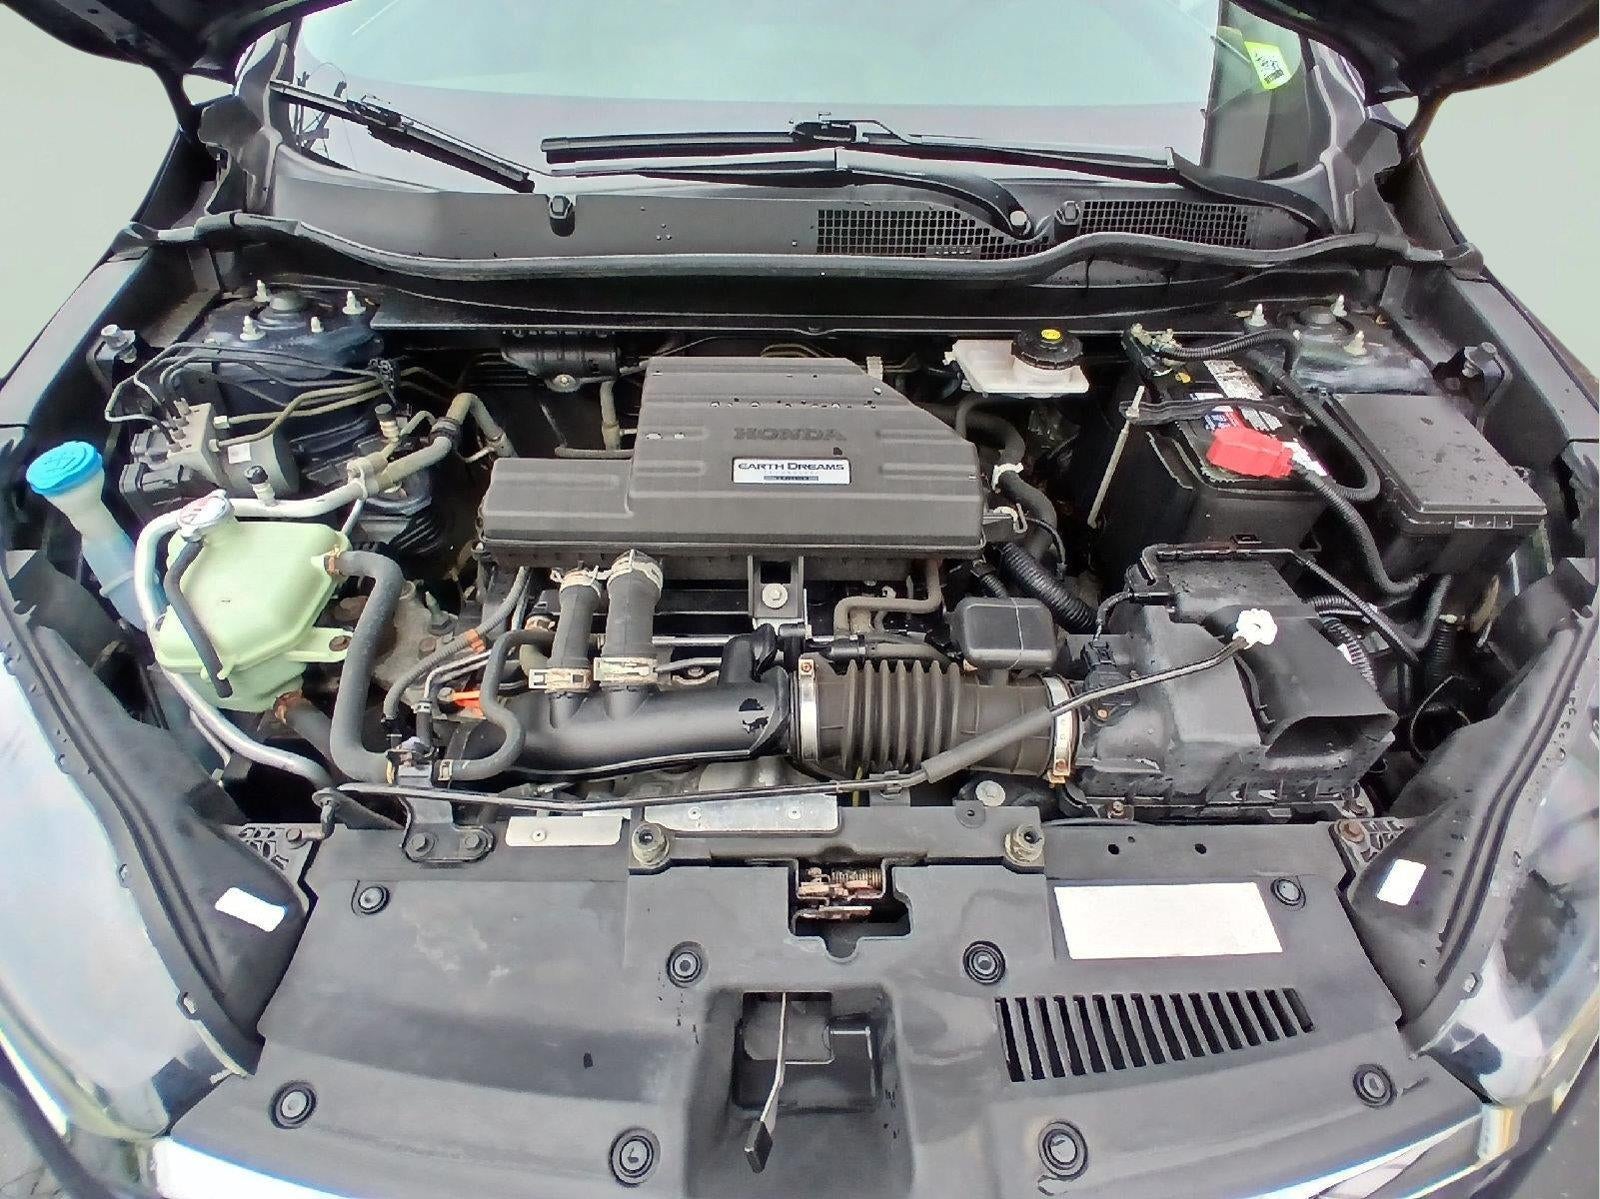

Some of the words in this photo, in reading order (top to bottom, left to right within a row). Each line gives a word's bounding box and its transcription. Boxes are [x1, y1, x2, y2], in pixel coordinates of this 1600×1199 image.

[734, 427, 847, 441] HONDA
[738, 462, 784, 471] EARTH
[787, 462, 844, 471] DREAMS
